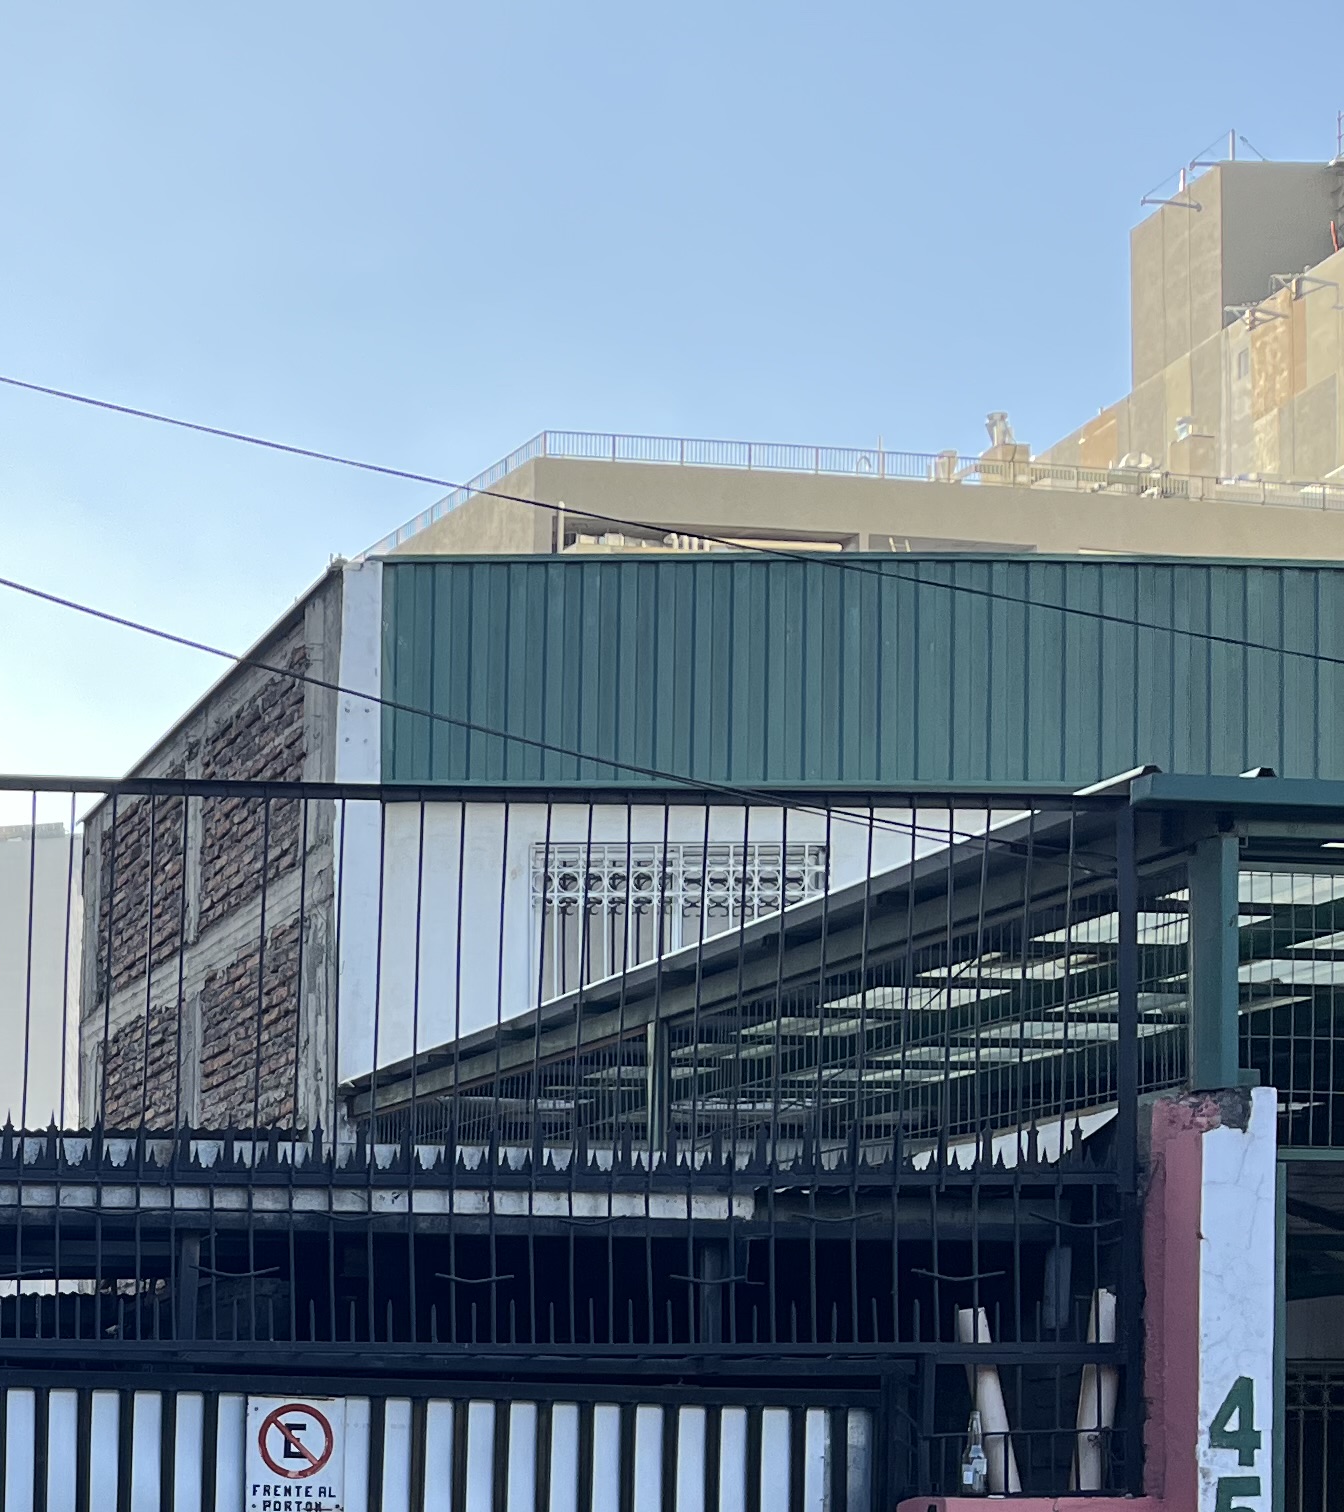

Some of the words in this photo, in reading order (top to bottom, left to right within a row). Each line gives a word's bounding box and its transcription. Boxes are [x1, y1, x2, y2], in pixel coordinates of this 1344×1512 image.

[284, 1423, 307, 1459] E
[252, 1484, 313, 1498] FRENTE
[318, 1486, 336, 1498] AL
[262, 1500, 322, 1512] PORTON
